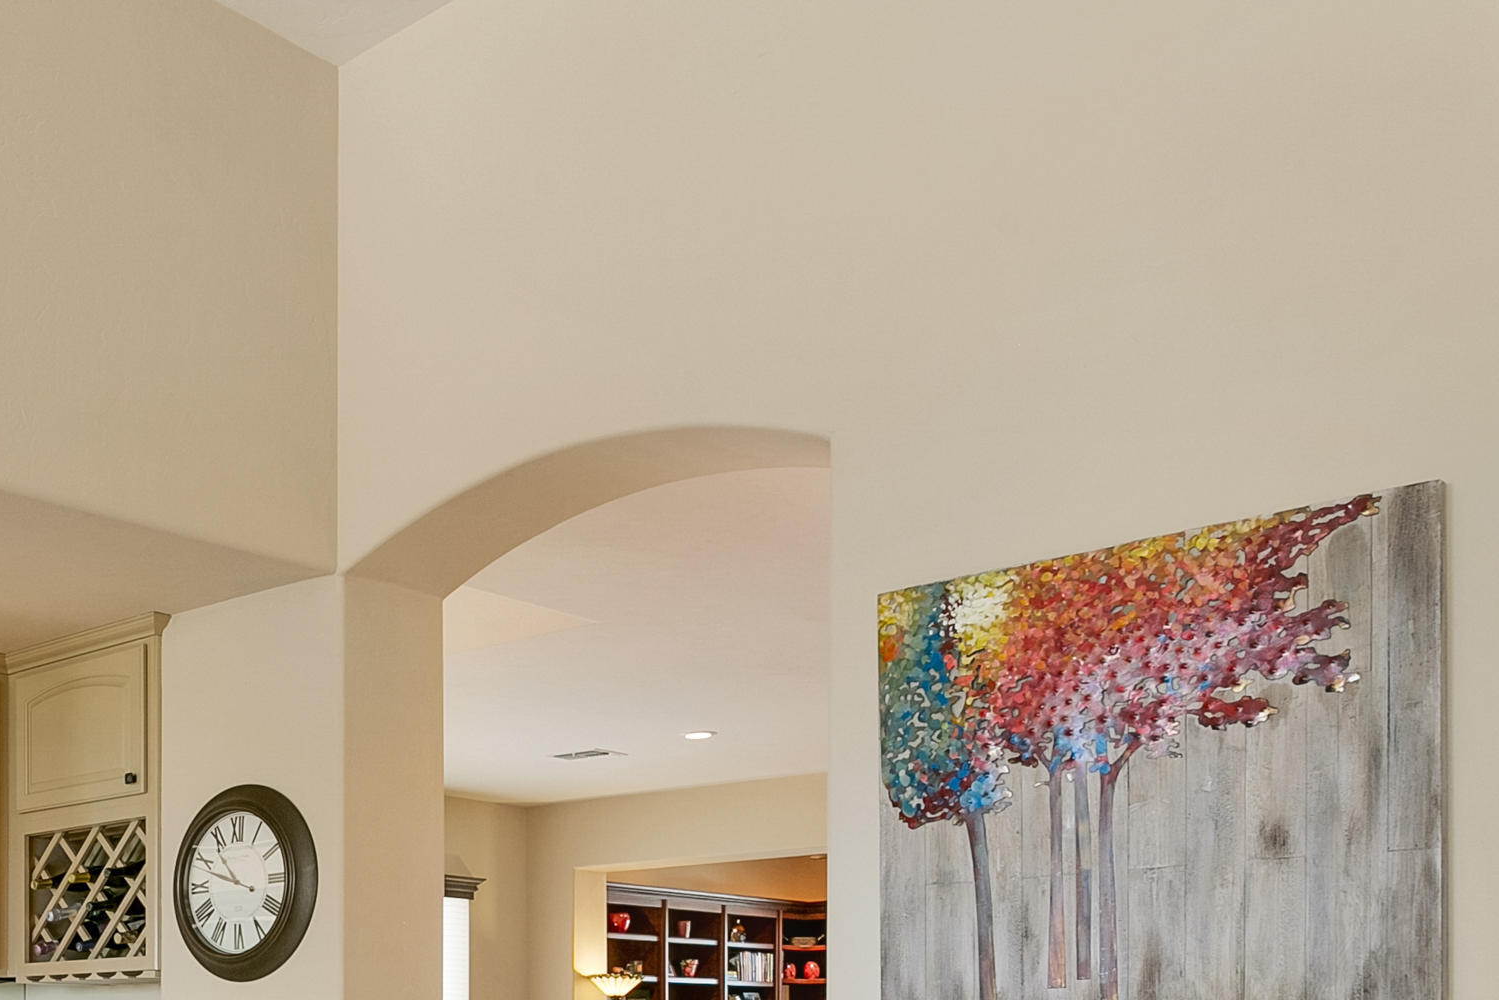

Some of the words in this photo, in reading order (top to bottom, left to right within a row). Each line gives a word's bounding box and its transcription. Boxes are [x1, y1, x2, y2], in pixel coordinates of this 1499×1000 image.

[211, 826, 226, 853] XI
[230, 816, 244, 843] XII
[196, 852, 214, 870] X
[191, 880, 209, 895] IX
[267, 872, 285, 884] III
[195, 898, 215, 927] VIII
[211, 917, 227, 945] VII
[234, 923, 244, 950] VI
